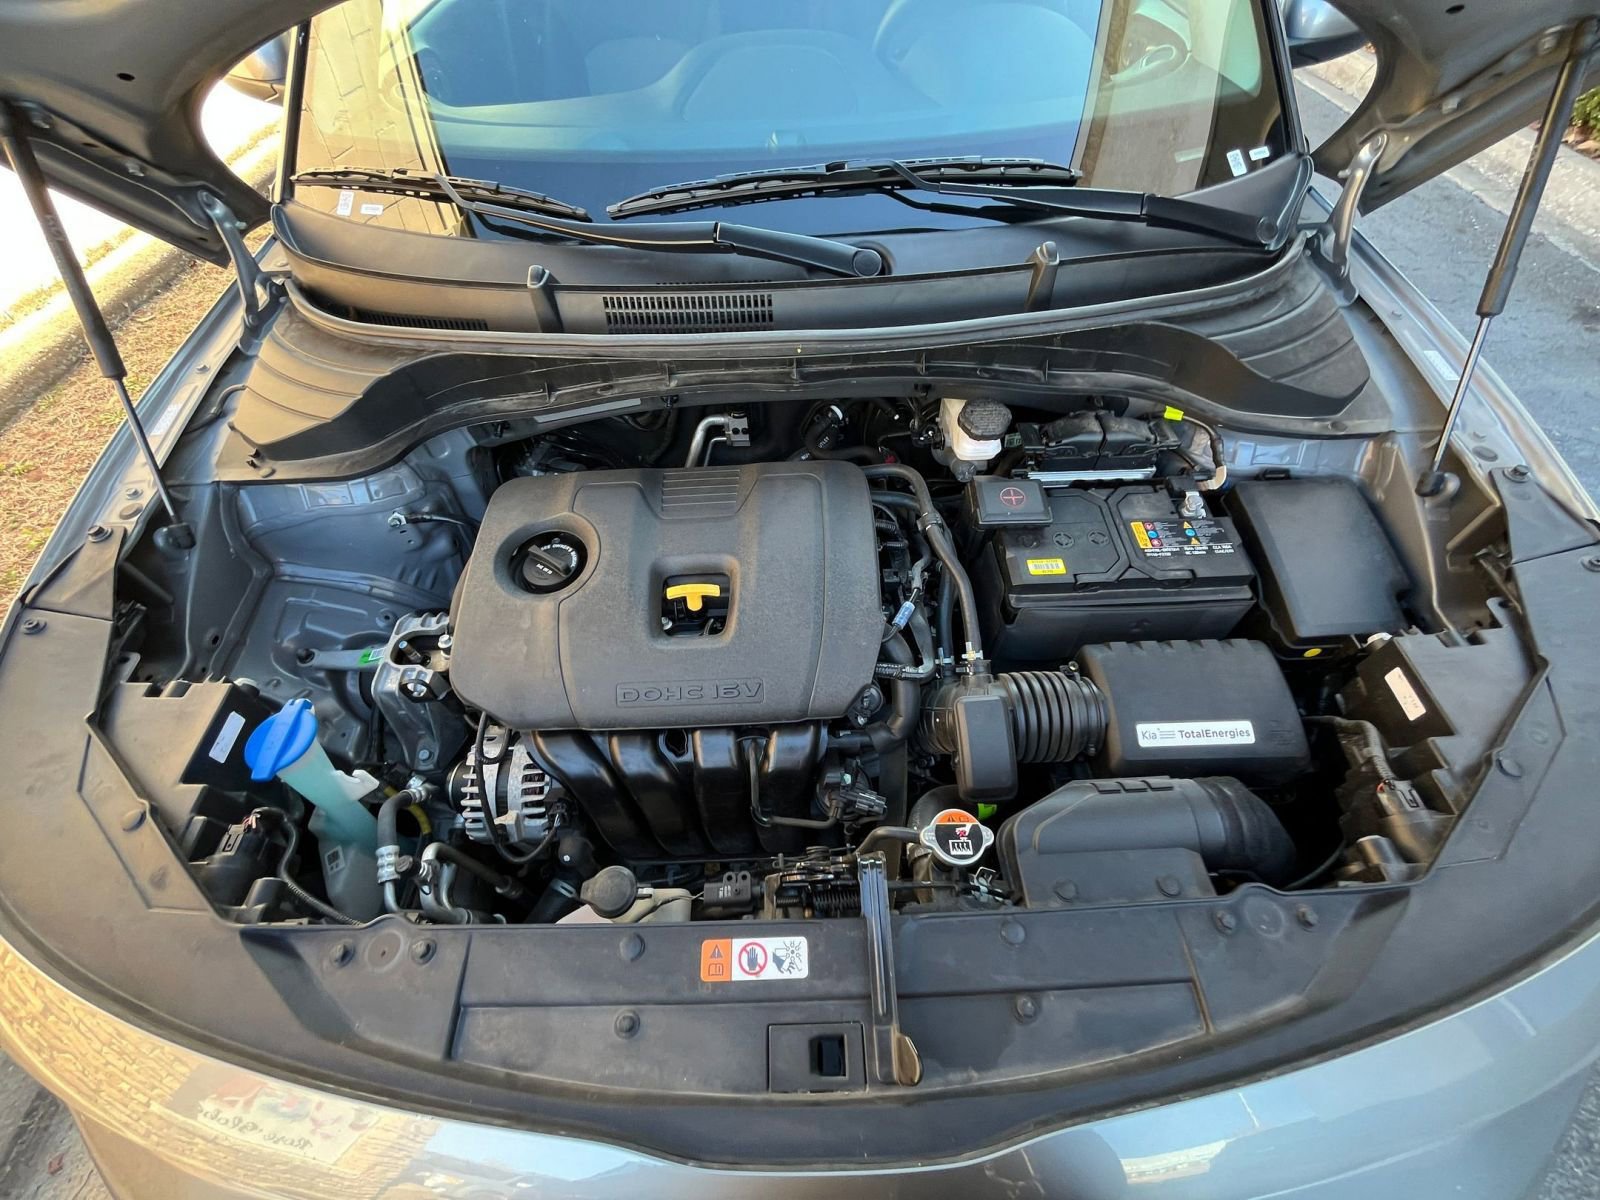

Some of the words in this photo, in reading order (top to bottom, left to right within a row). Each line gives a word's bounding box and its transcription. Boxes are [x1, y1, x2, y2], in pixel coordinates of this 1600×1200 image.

[619, 684, 704, 703] DOHC
[712, 682, 762, 699] 16V
[1141, 730, 1158, 740] Kia
[1178, 728, 1251, 739] TotalEnergies
